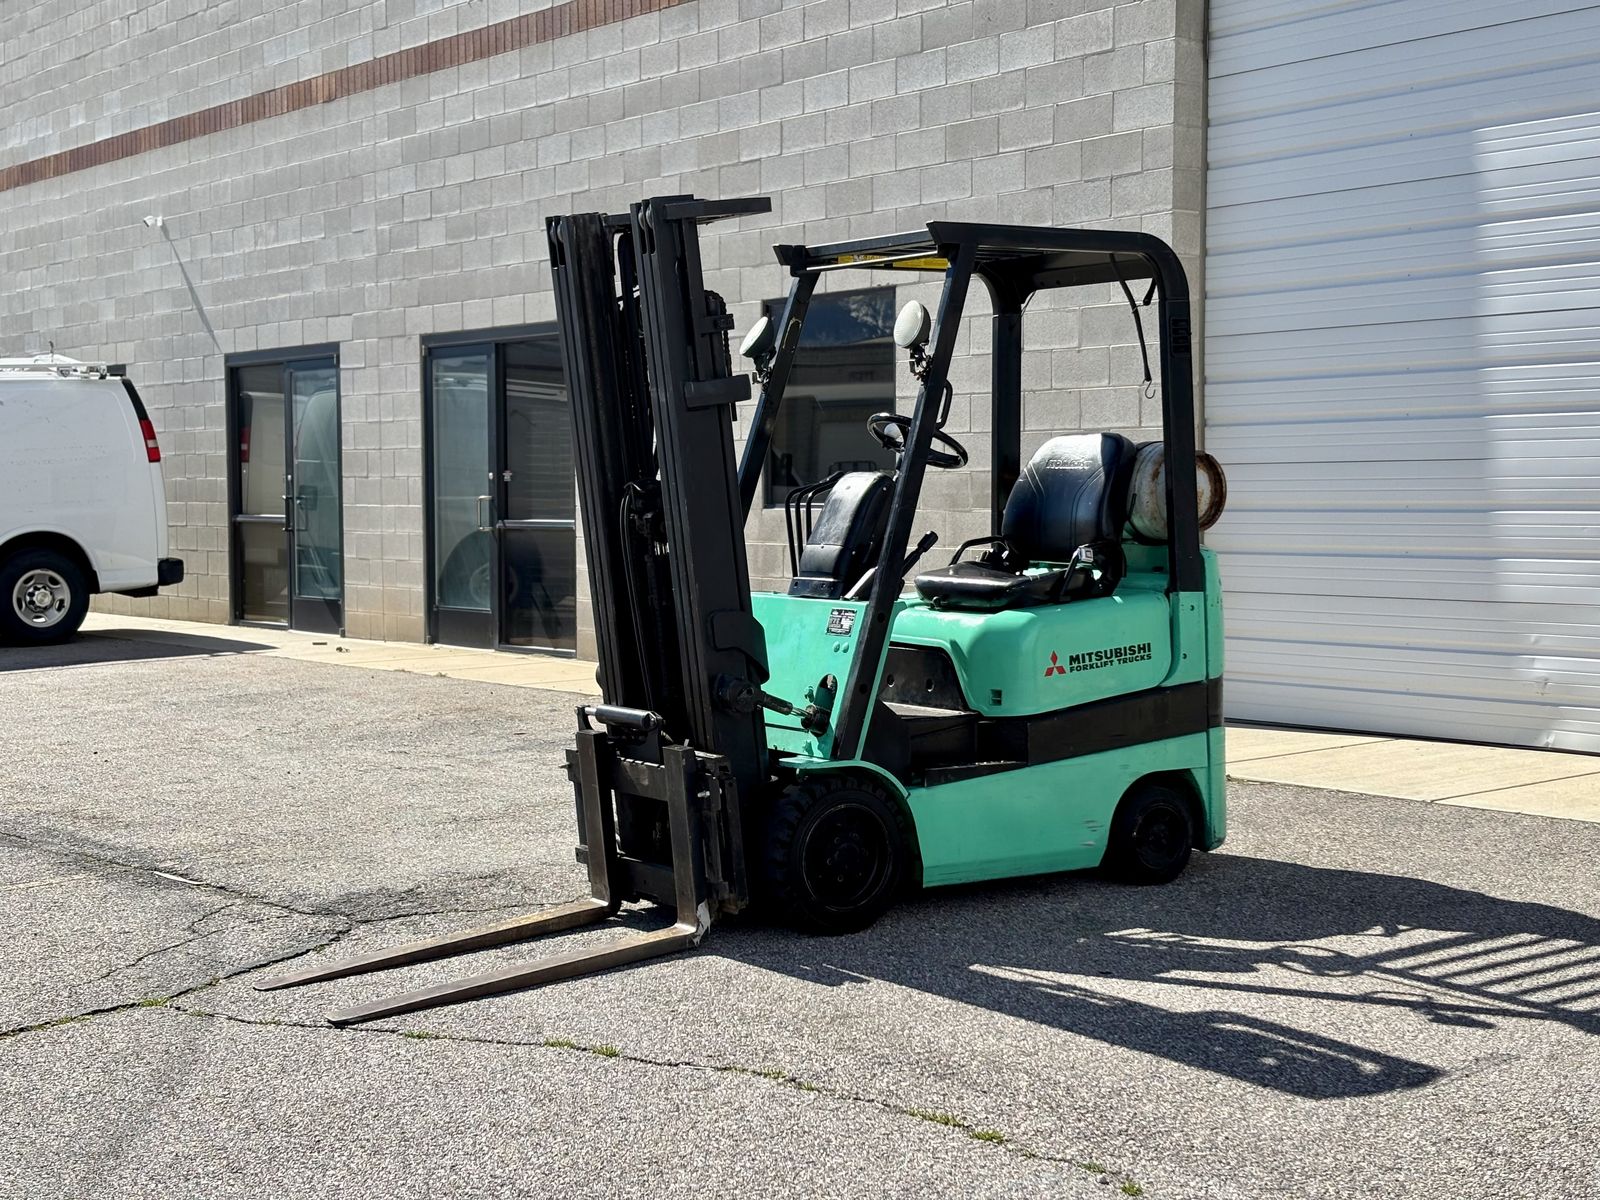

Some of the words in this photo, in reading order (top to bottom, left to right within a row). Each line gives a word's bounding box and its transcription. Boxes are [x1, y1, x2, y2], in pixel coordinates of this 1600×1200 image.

[1069, 642, 1151, 666] MITSUBISHI
[1069, 659, 1114, 673] FORKLIFT
[1118, 653, 1152, 665] TRUCKS
